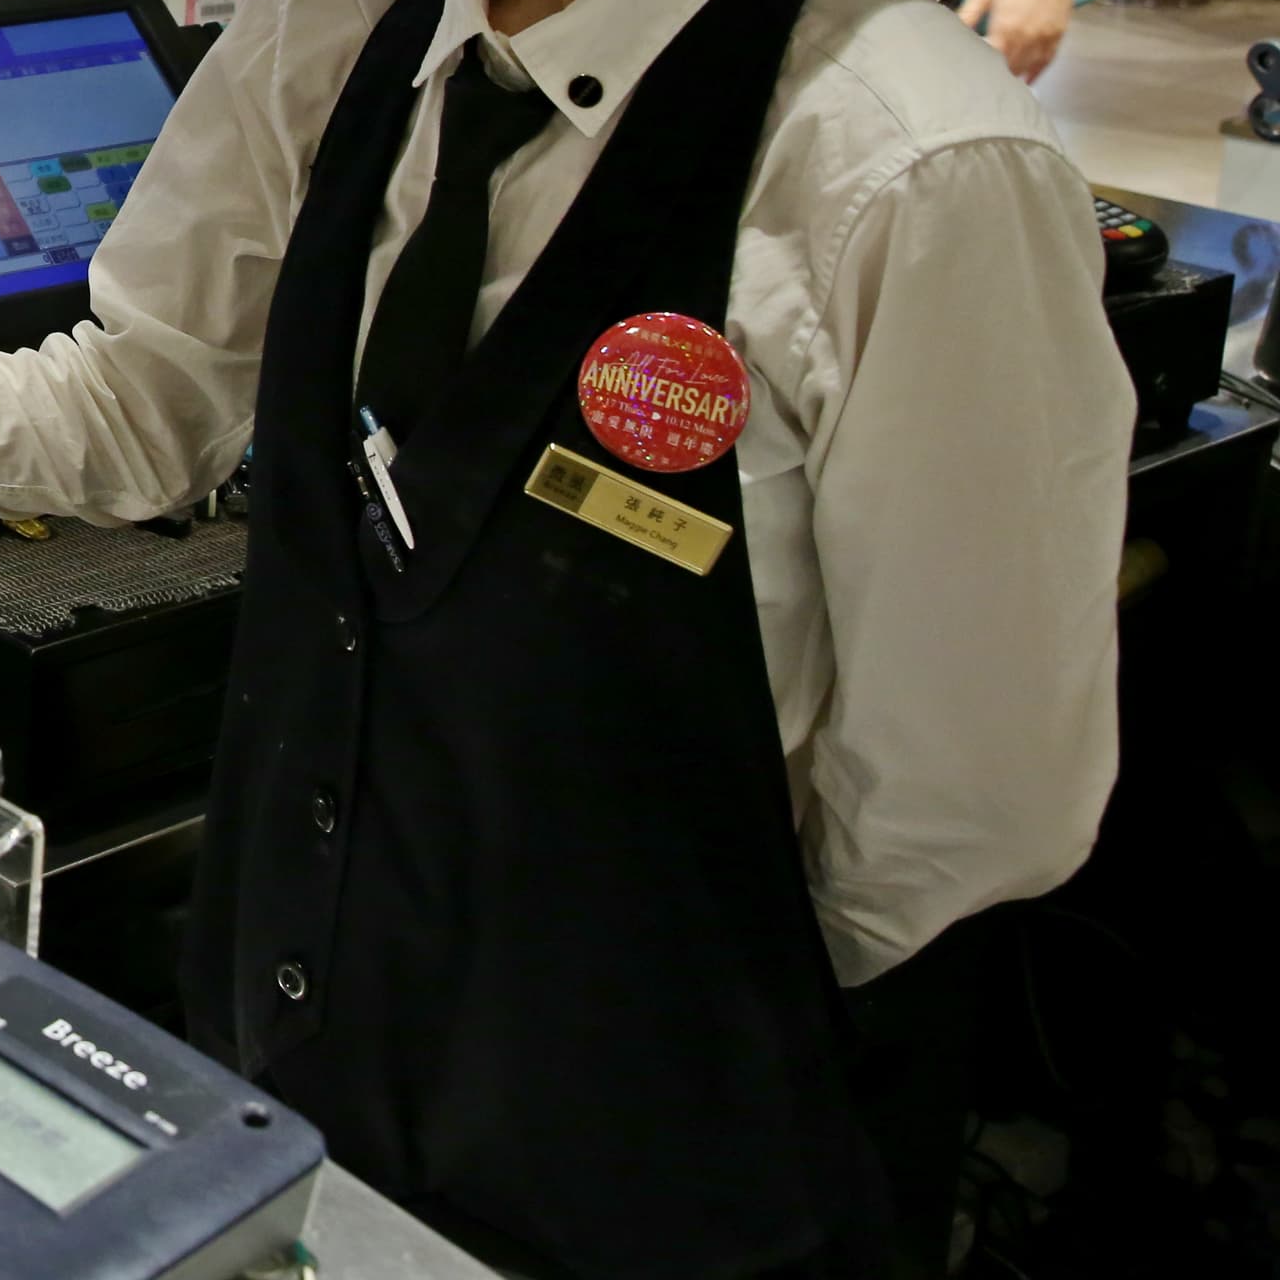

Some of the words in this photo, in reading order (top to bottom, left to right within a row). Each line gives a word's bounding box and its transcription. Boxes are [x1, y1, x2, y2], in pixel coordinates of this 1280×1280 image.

[582, 360, 742, 427] ANNIVERSARY
[648, 529, 678, 551] Chang
[42, 1018, 149, 1091] Breeze
